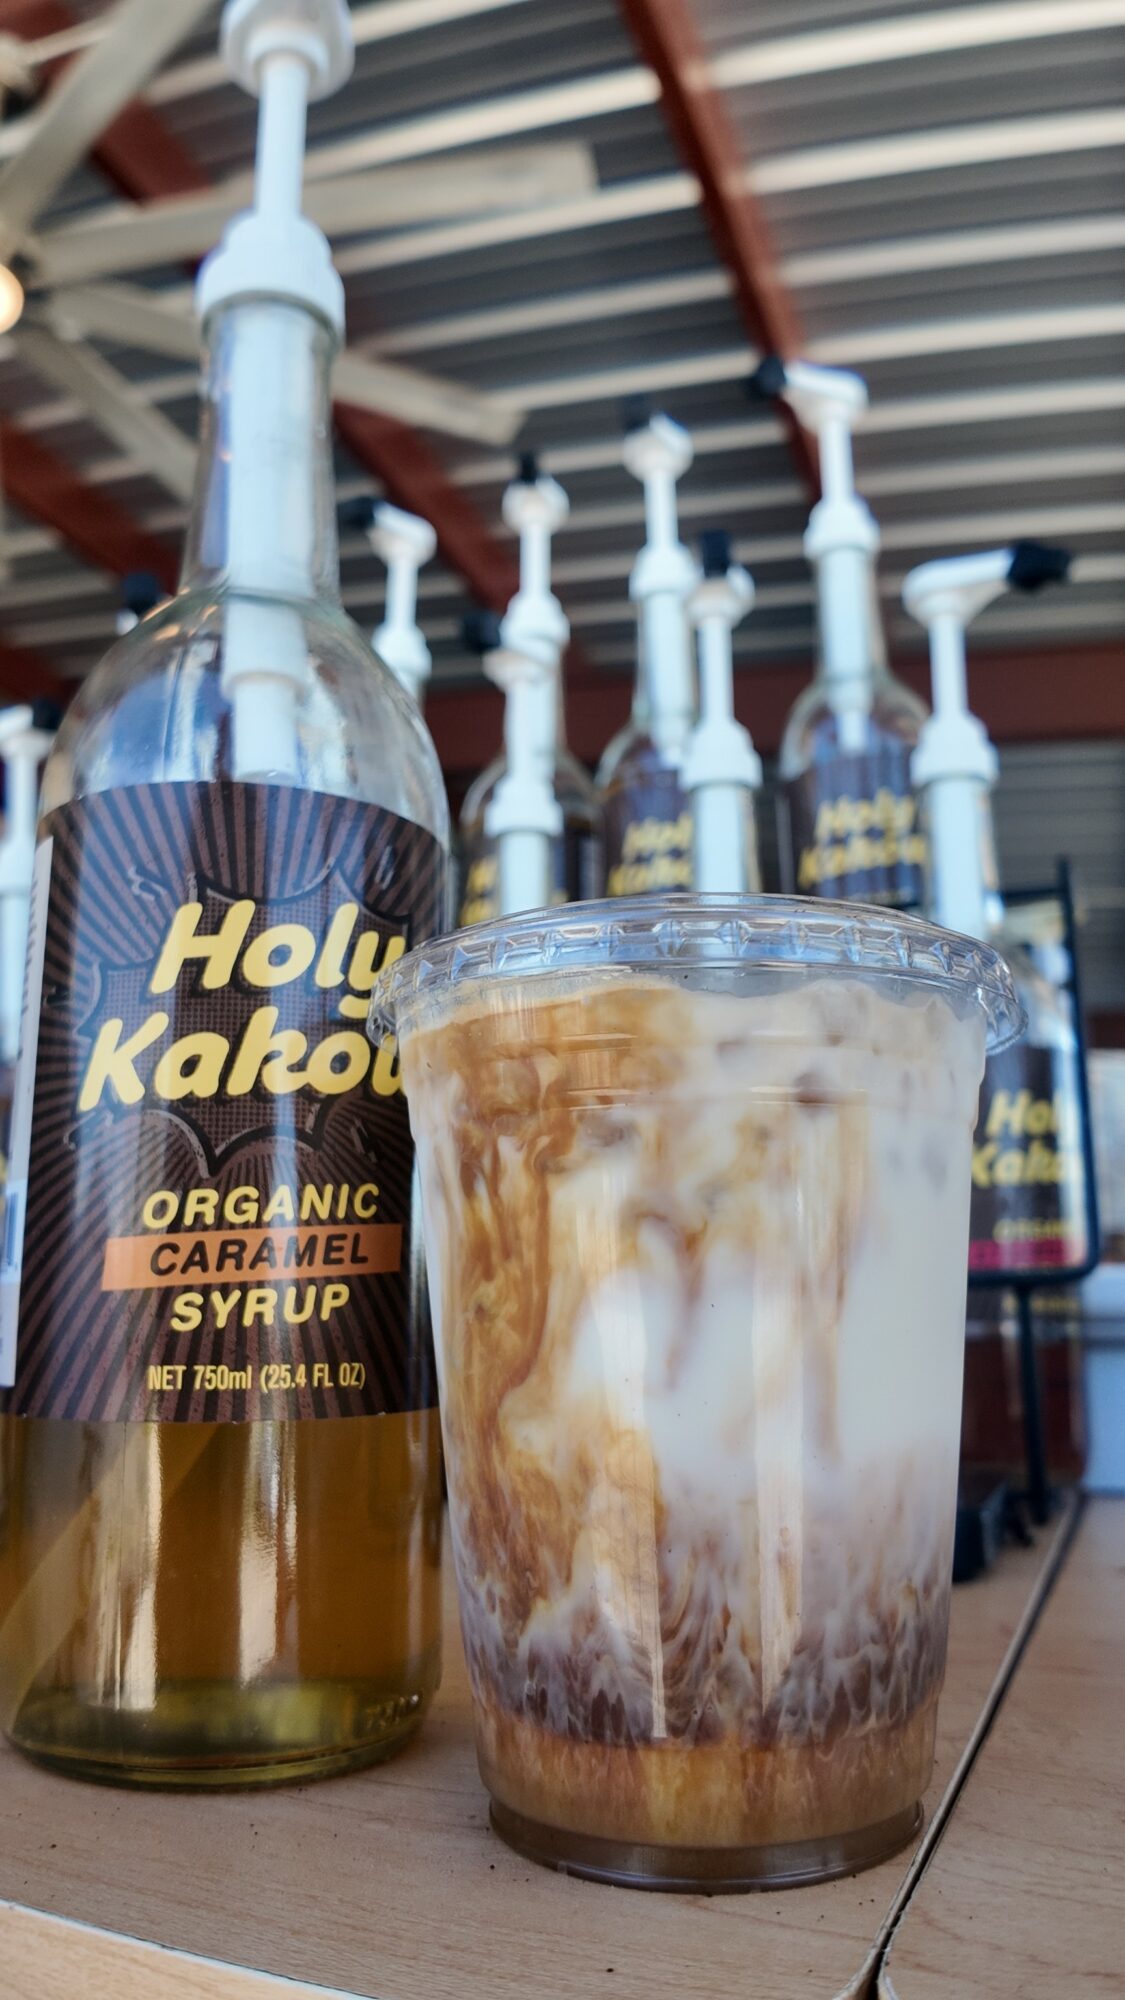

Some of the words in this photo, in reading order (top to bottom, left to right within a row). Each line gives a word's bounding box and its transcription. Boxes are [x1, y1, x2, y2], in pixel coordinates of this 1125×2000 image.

[150, 899, 406, 1019] Holy
[142, 1182, 380, 1229] ORGANIC
[150, 1232, 370, 1277] CARAMEL
[170, 1283, 350, 1332] SYRUP
[148, 1365, 187, 1390] NET
[193, 1364, 252, 1390] 750ml
[260, 1364, 307, 1392] (25.4
[313, 1364, 333, 1388] FL
[339, 1362, 366, 1391] OZ)
